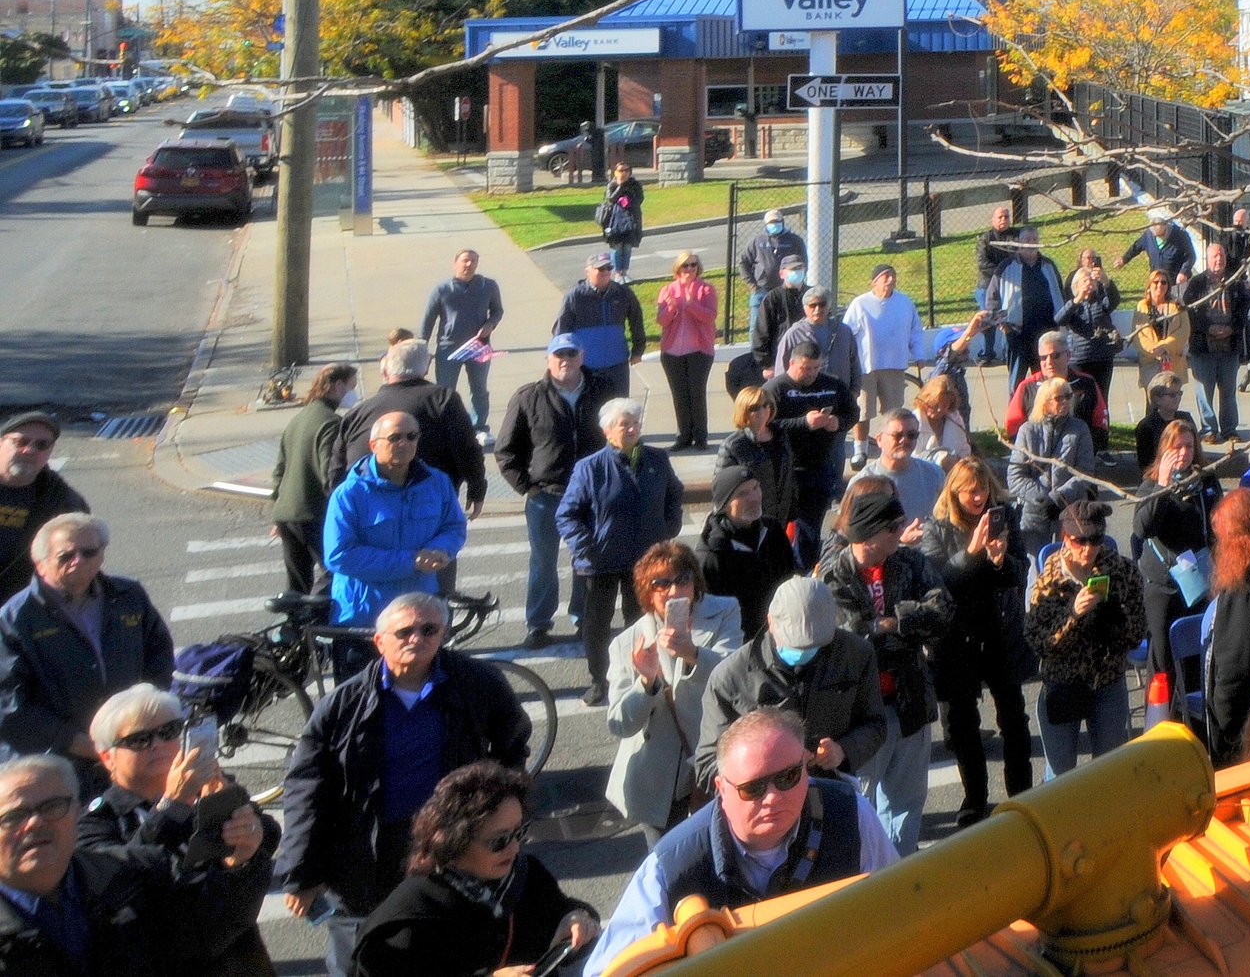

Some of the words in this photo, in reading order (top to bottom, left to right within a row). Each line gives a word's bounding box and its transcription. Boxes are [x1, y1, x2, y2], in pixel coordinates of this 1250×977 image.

[805, 12, 843, 20] BANK
[553, 36, 591, 51] Valley
[807, 86, 839, 97] ONE
[853, 86, 886, 97] WAY
